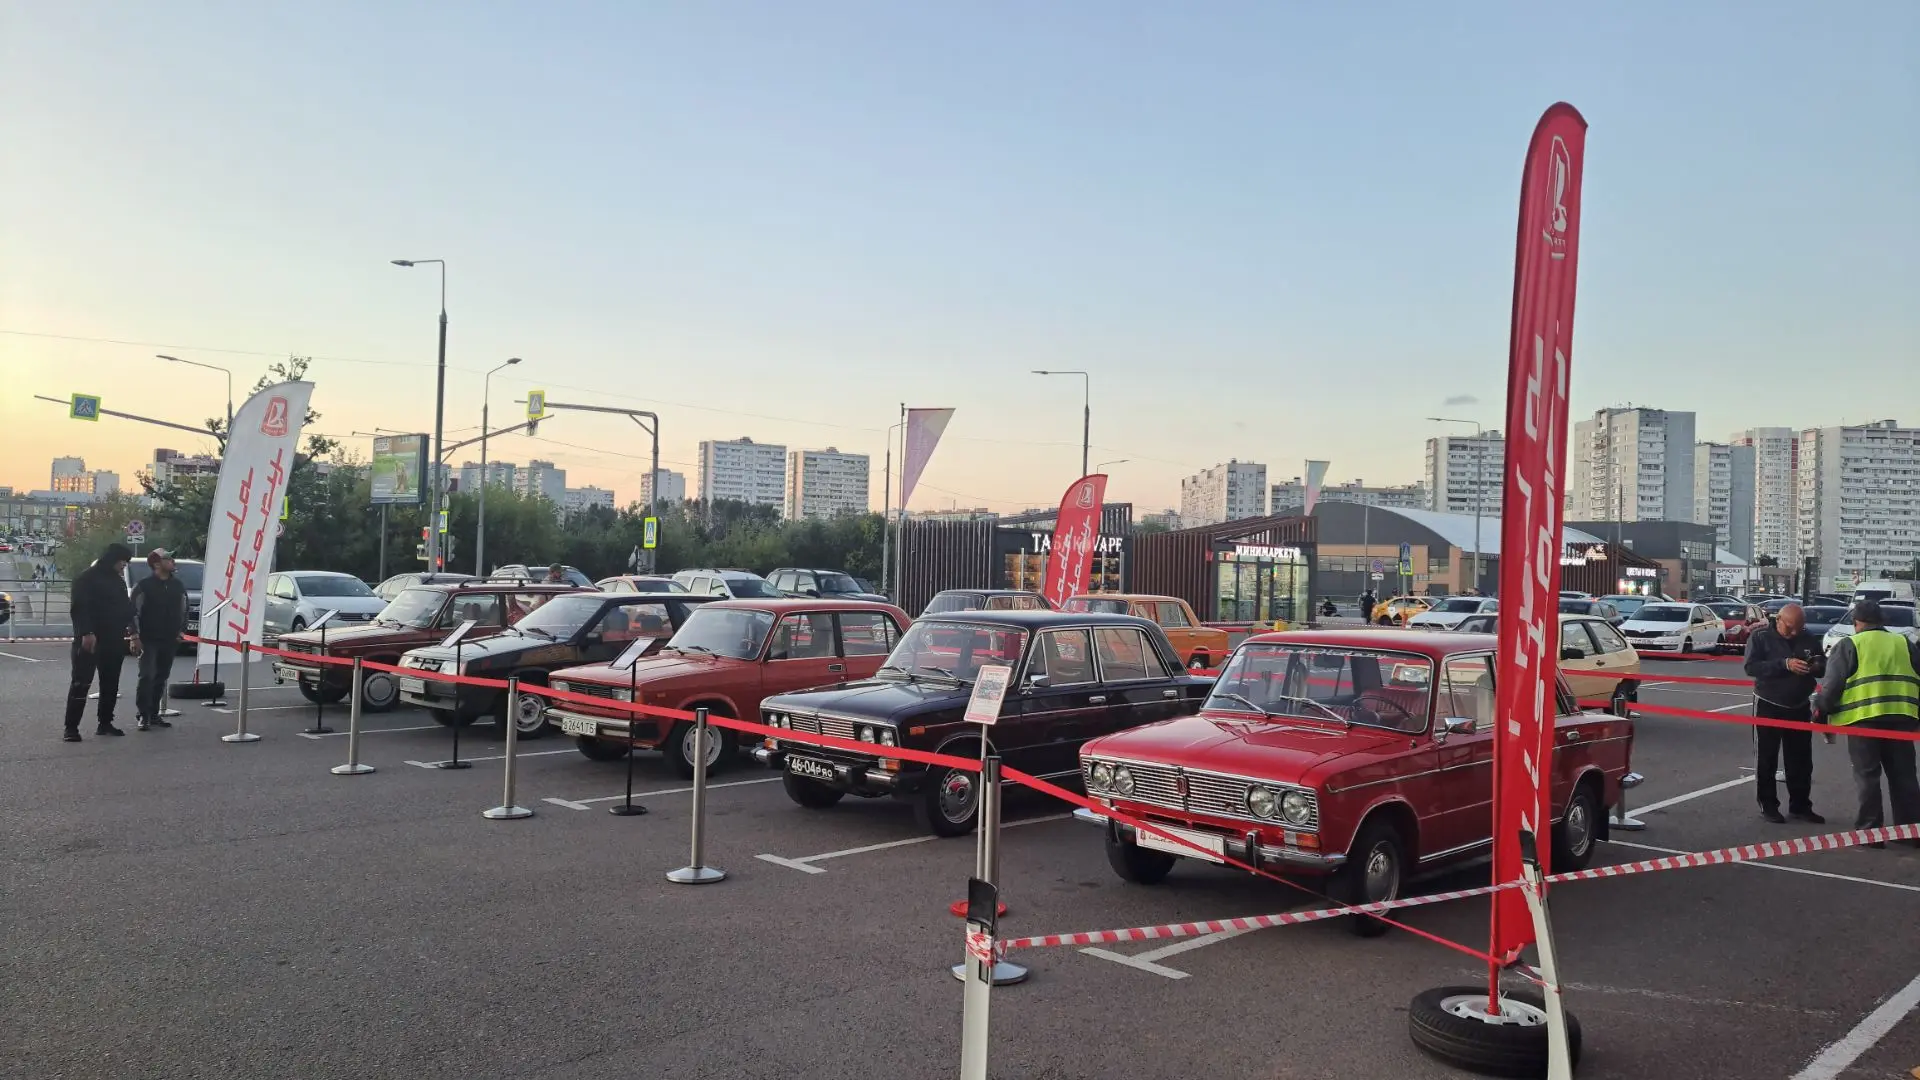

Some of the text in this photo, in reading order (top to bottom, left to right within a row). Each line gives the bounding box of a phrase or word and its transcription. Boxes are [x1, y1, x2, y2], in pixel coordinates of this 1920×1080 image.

[214, 466, 254, 602] Lada
[1049, 525, 1074, 608] Lada
[1235, 544, 1294, 559] МИНИМАРКЕТ
